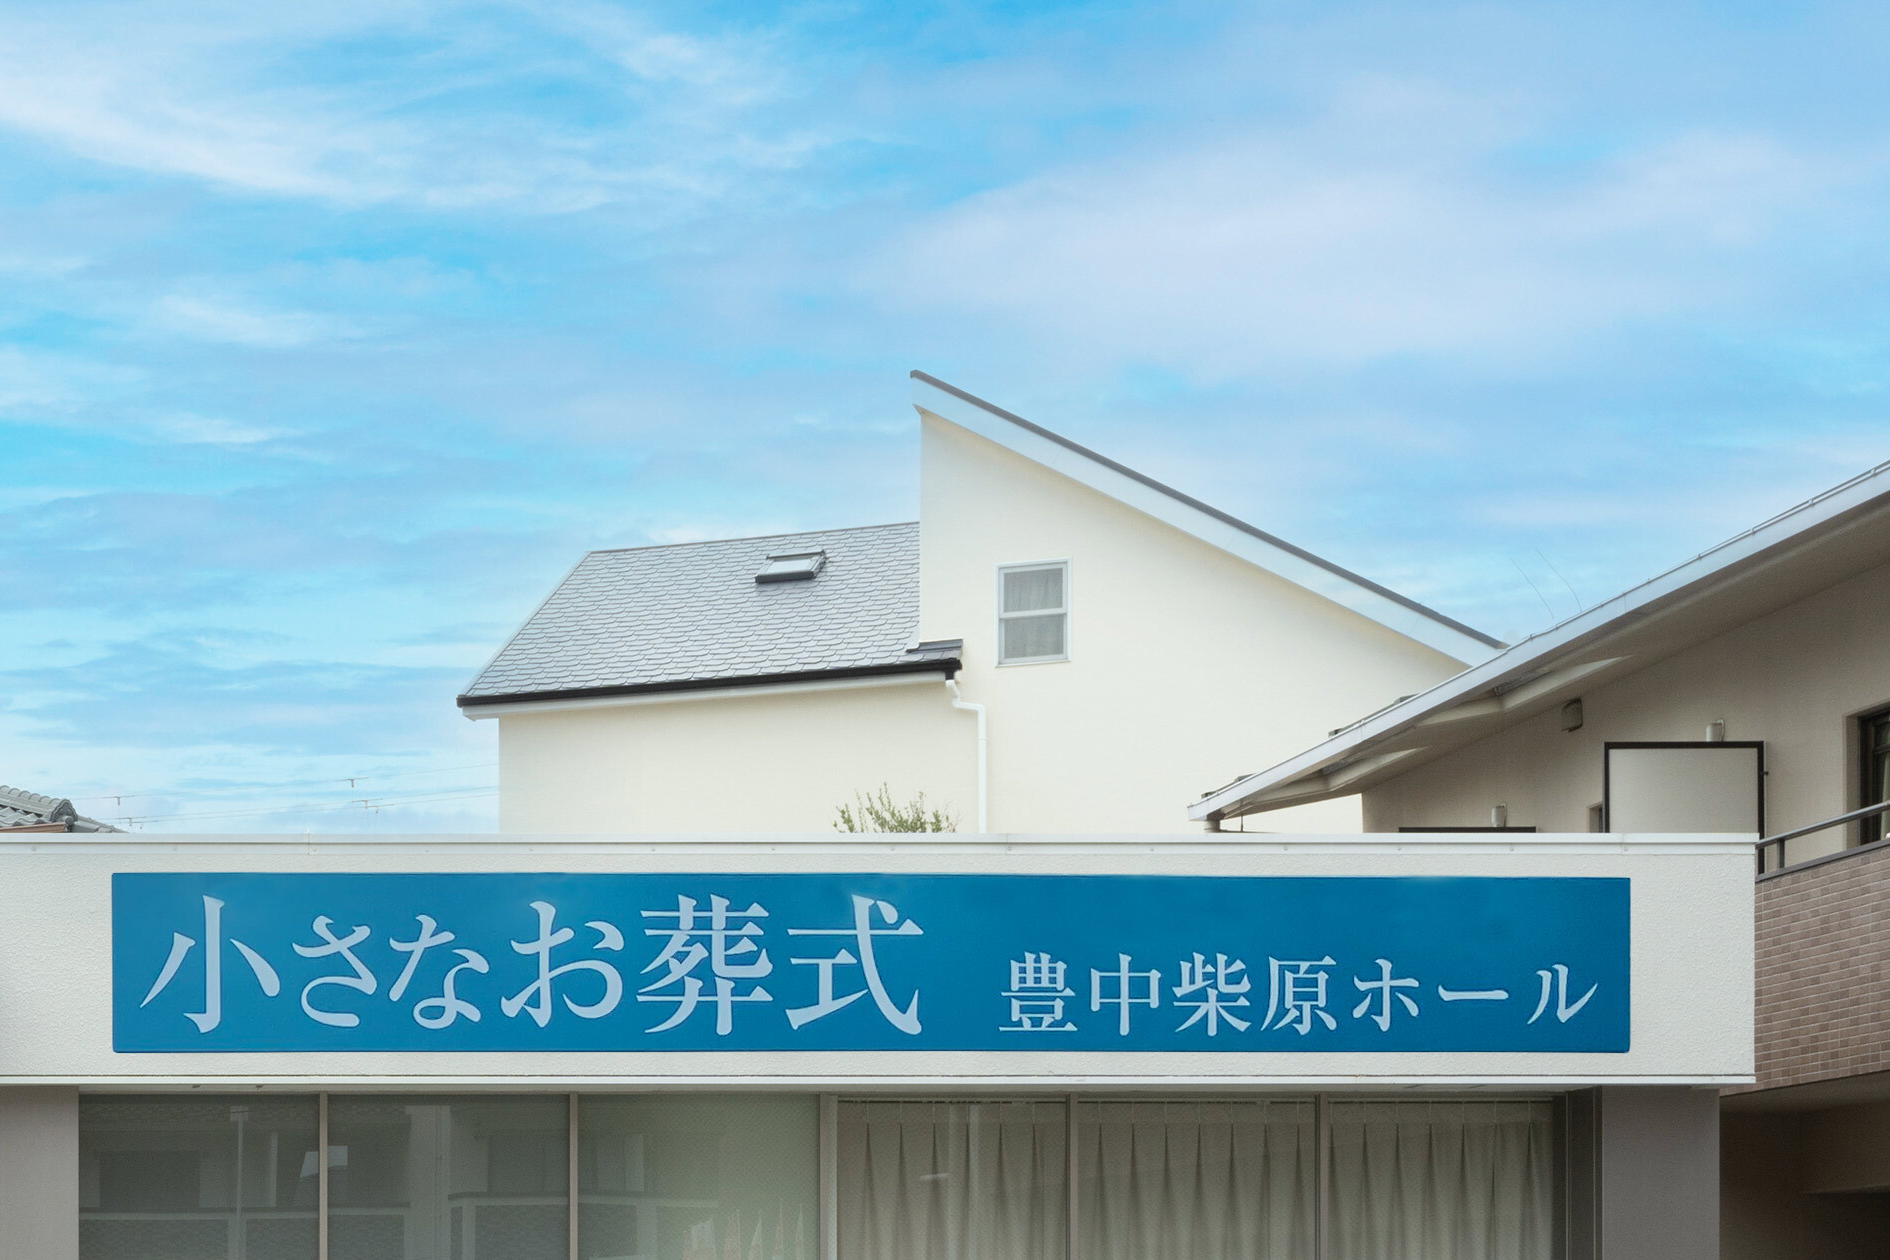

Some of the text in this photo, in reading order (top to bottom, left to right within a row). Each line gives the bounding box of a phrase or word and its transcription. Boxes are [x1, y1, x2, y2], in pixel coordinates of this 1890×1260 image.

[141, 894, 1597, 1036] 小さなお葬式 豊中柴原ホール
